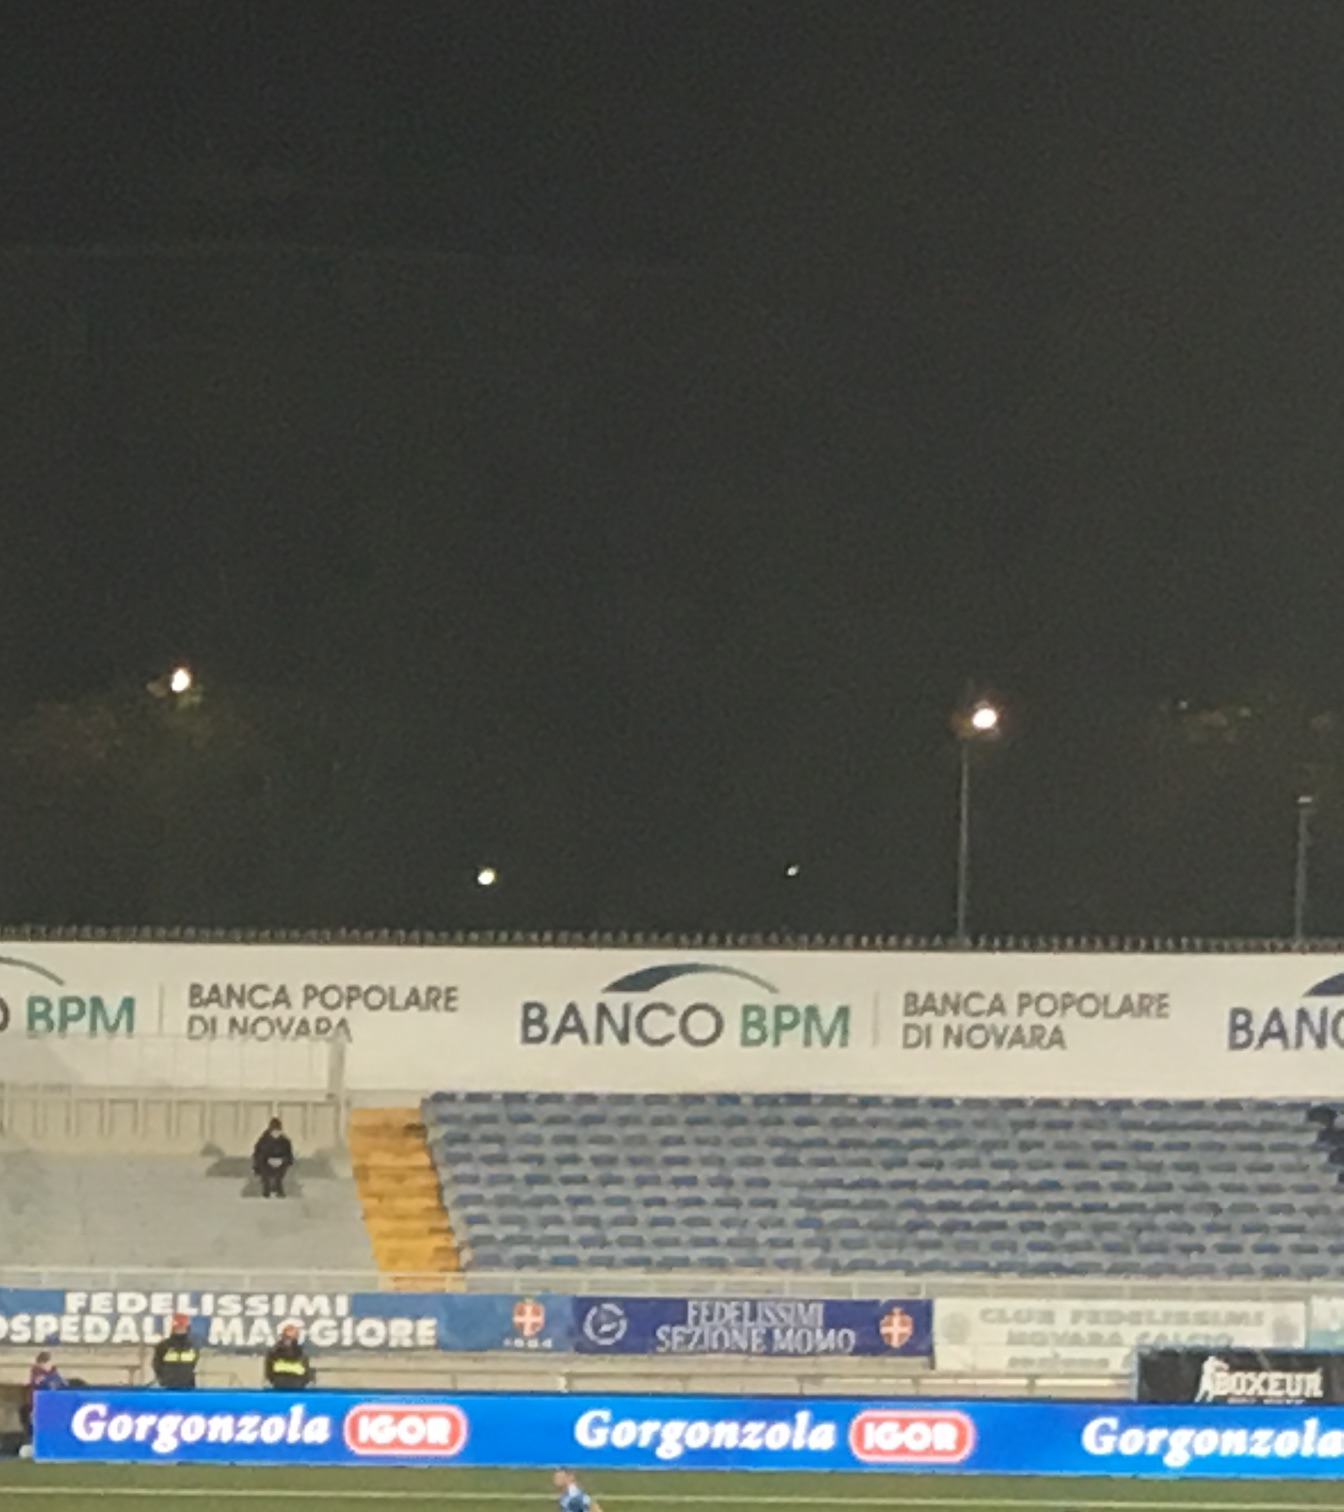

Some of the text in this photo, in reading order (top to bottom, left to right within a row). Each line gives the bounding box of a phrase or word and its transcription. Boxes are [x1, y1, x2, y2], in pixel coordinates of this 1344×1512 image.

[188, 983, 459, 1012] BANCA POPOLARE
[902, 992, 1170, 1019] BANCA POPOLARE
[26, 996, 136, 1039] BPM
[187, 1015, 353, 1043] DI NOVARA
[521, 1002, 850, 1048] BANCO BPM
[902, 1023, 1067, 1050] DI NOVARA
[65, 1291, 350, 1317] FEDELISSIMI
[687, 1301, 824, 1328] FEDELISSIMI
[656, 1325, 857, 1353] SEZIONE MOMO
[71, 1403, 451, 1454] Gorgonzola IGOR
[575, 1409, 957, 1460] Gorgonzola IGOR
[1082, 1416, 1344, 1468] Gorgonzola
